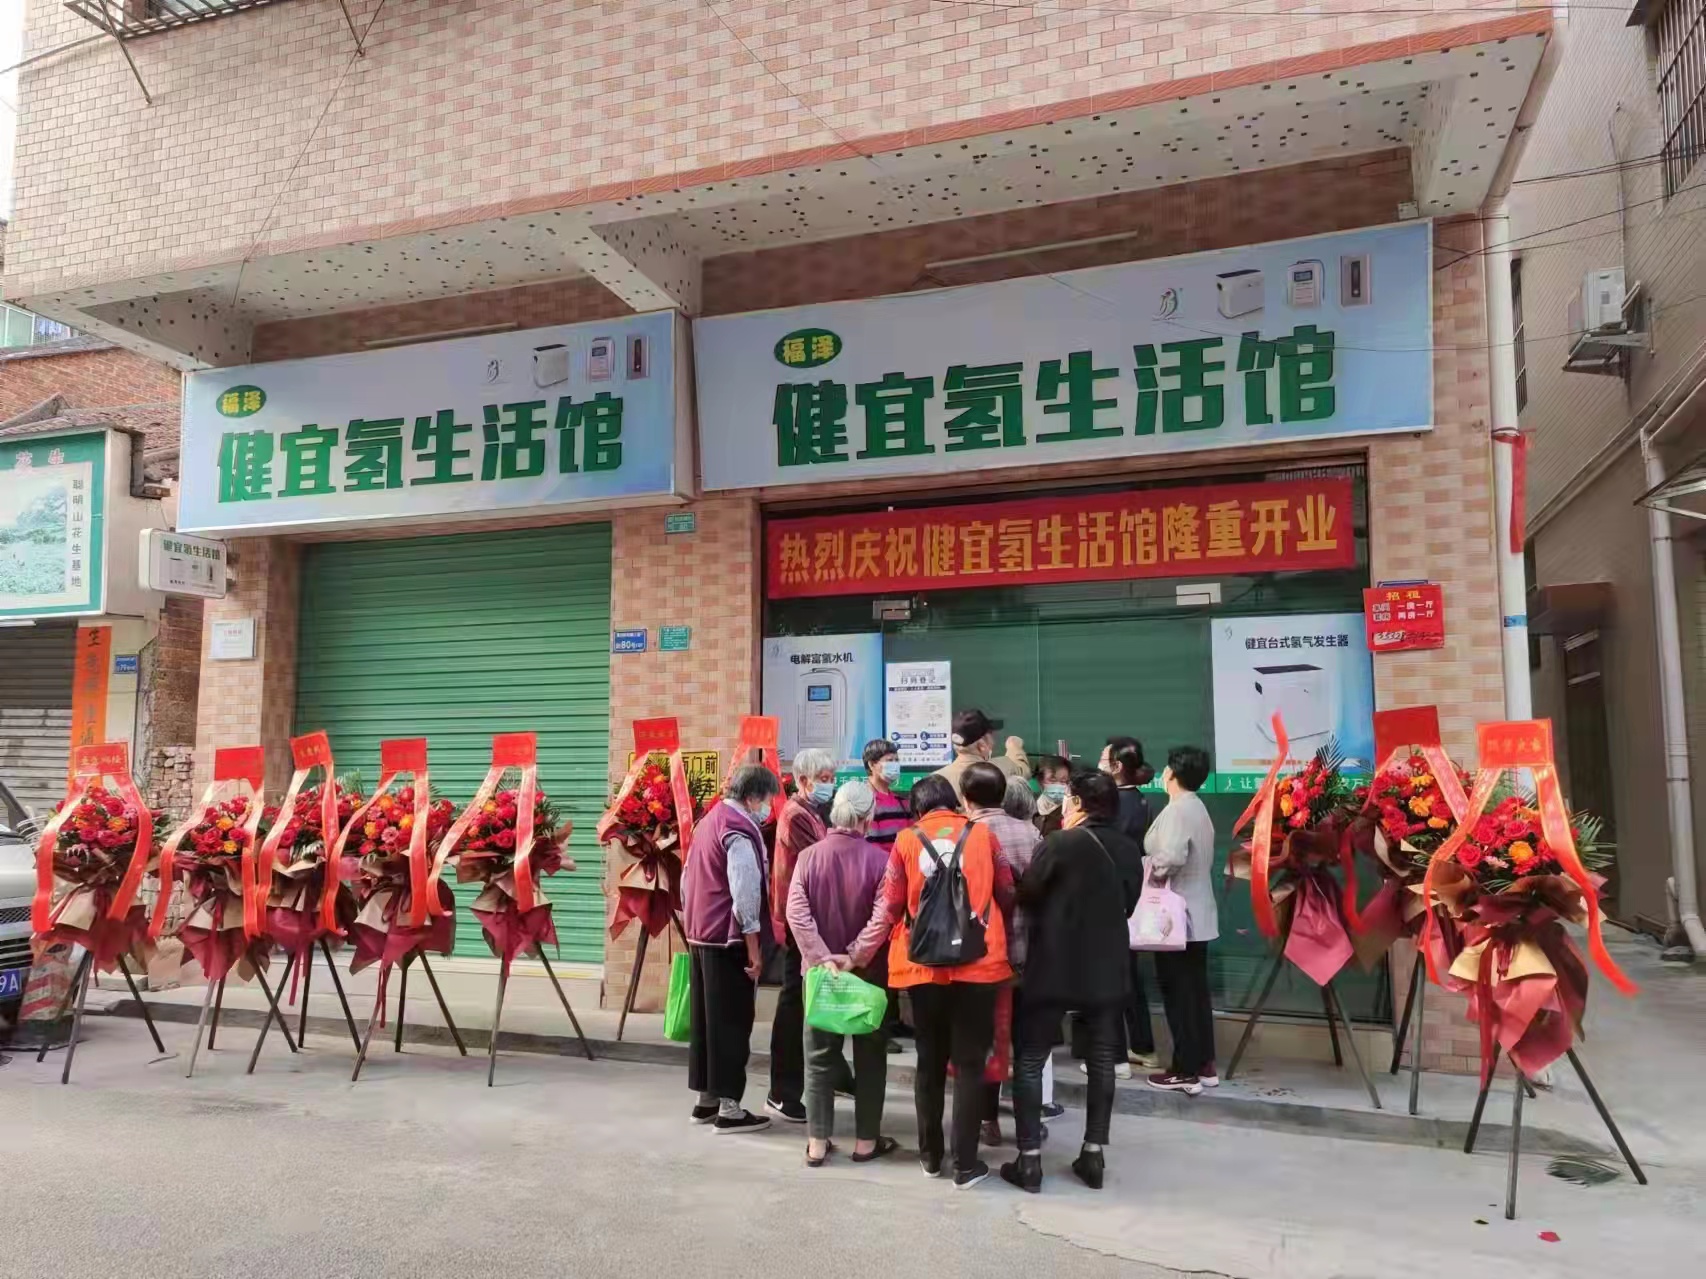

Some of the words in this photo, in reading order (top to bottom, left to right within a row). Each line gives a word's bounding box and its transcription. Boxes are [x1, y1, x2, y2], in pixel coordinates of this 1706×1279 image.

[783, 336, 837, 364] 福泽
[222, 390, 263, 415] 福泽
[772, 325, 1336, 467] 健宜氢生活馆
[217, 391, 624, 503] 健宜氢生活馆
[779, 494, 1338, 584] 热烈庆祝健宜氢生活馆隆重开业
[1245, 634, 1349, 650] 健宜台式氢气发生器
